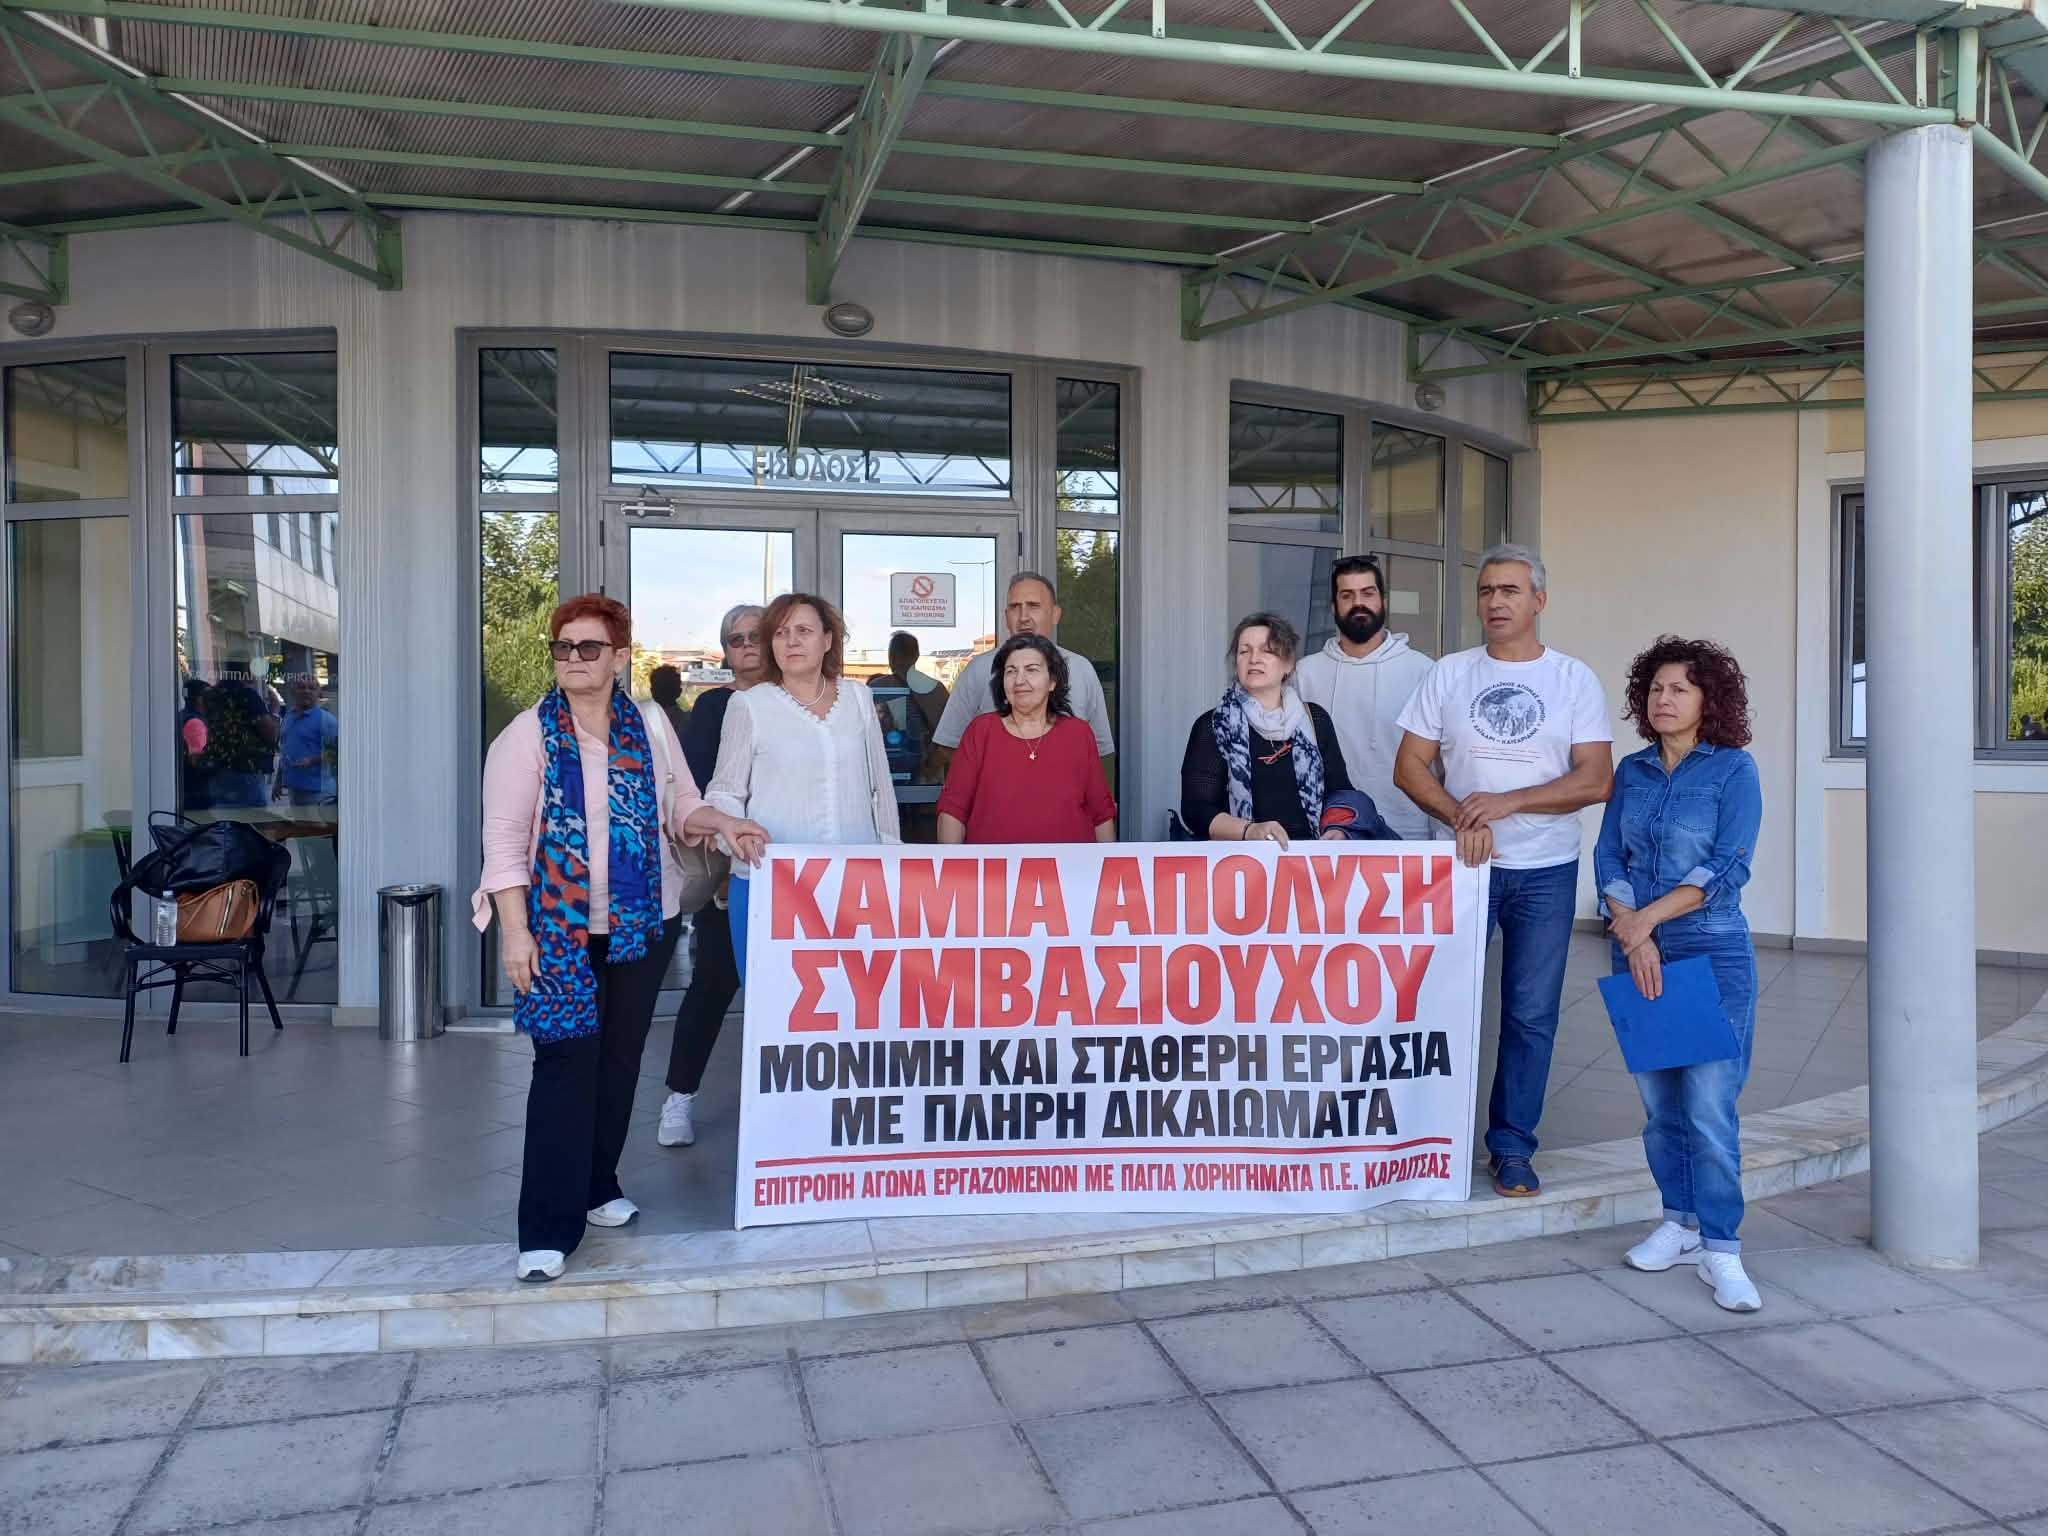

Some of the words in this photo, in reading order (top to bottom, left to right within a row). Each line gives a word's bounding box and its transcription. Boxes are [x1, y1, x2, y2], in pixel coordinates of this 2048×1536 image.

[753, 450, 861, 482] ΕΙΣΟΔΟΣ
[867, 456, 881, 483] 2
[771, 857, 1070, 940] ΚΑΜΙΑ
[1091, 855, 1453, 937] ΑΠΟΛΥΣΗ
[788, 943, 1434, 1032] ΣΥΜΒΑΣΙΟΥΧΟΥ
[759, 1039, 964, 1093] ΜΟΝΙΜΗ
[979, 1037, 1058, 1086] ΚΑΙ
[1071, 1035, 1267, 1083] ΣΤΑΘΕΡΗ
[1282, 1031, 1451, 1082] ΕΡΓΑΣΙΑ
[831, 1095, 903, 1146] ΜΕ
[924, 1092, 1086, 1142] ΠΛΗΡΗ
[1102, 1088, 1398, 1138] ΔΙΚΑΙΩΜΑΤΑ
[755, 1172, 855, 1206] ΕΠΙΤΡΟΠΗ
[861, 1169, 926, 1198] ΑΓΩΝΑ
[934, 1164, 1078, 1195] ΕΡΓΑΖΟΜΕΝΩΝ
[1085, 1163, 1114, 1191] ΜΕ
[1121, 1163, 1177, 1191] ΠΑΓΙΑ
[1183, 1163, 1313, 1191] ΧΟΡΗΓΗΜΑΤΑ
[1320, 1163, 1359, 1190] Π.Ε.
[1364, 1152, 1451, 1189] ΚΑΡΔΙΤΣΑΣ
